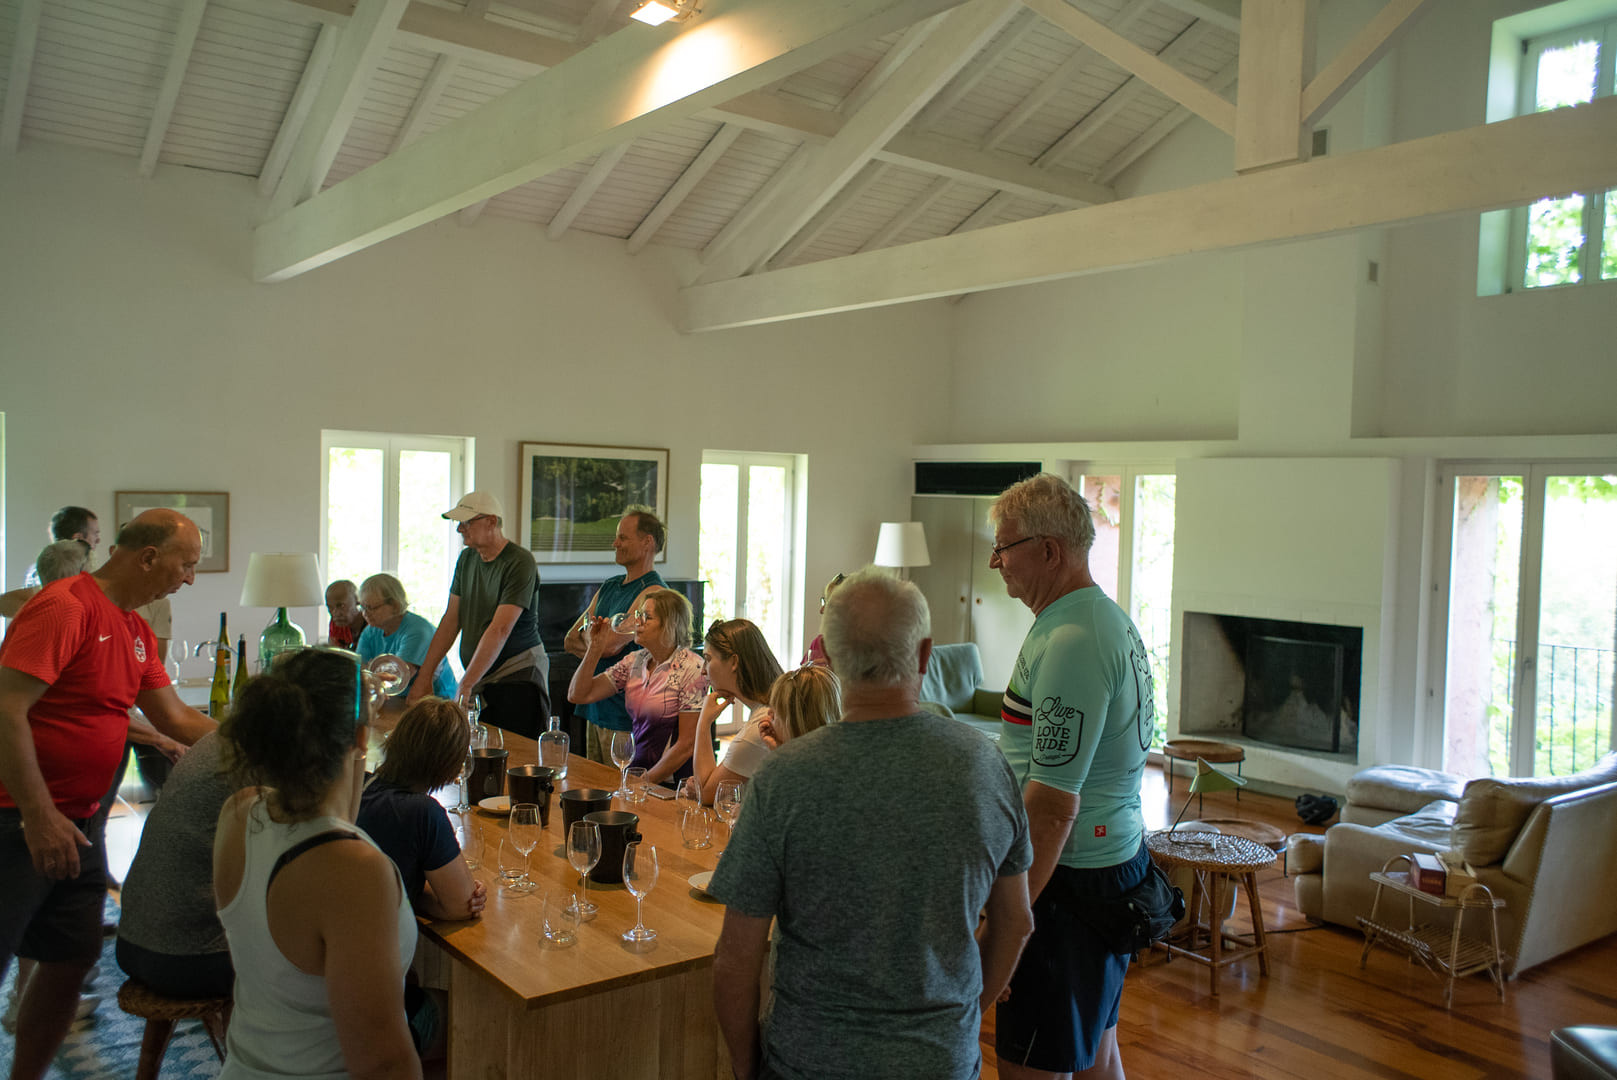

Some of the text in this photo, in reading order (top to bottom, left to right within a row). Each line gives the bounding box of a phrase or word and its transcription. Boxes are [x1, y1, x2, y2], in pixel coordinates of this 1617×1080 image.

[1038, 696, 1075, 726] Live
[1037, 726, 1070, 739] LOVE
[1035, 738, 1068, 751] RIDE
